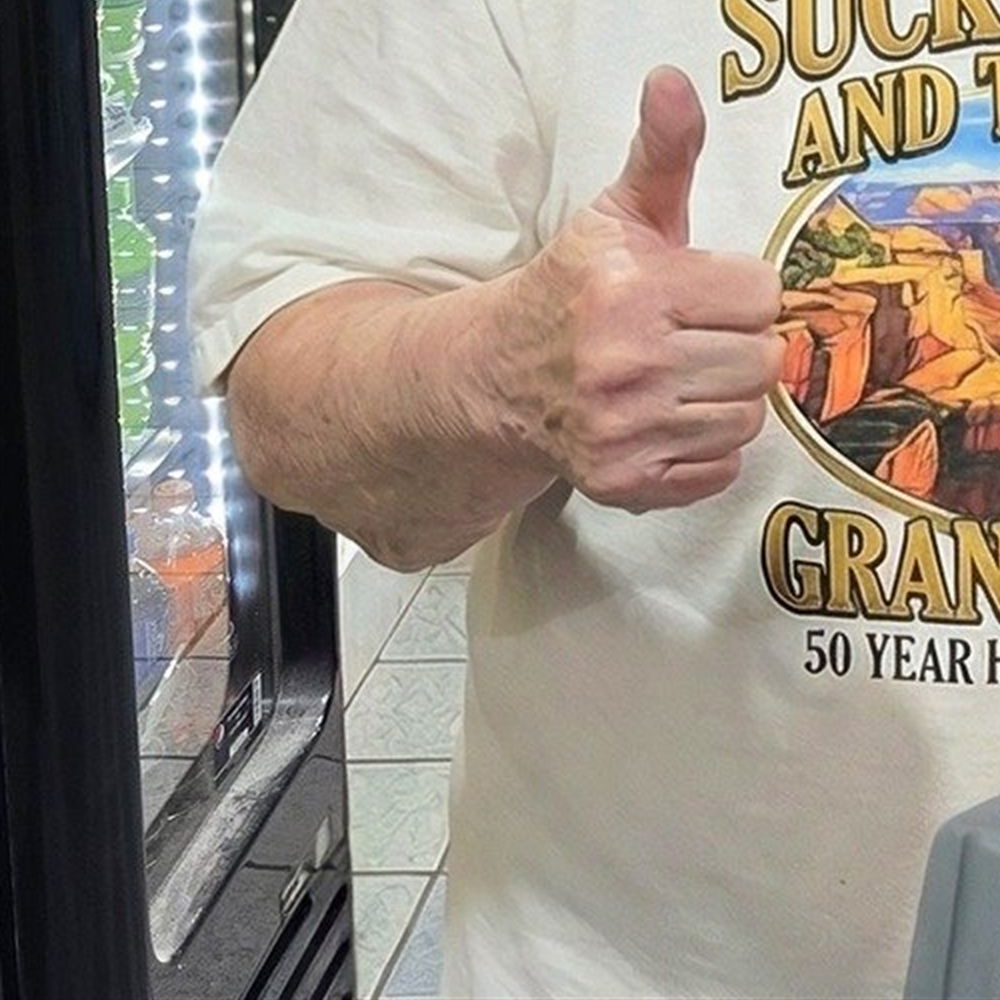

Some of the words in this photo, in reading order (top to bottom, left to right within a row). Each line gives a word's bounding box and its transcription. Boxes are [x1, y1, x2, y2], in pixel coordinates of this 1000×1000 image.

[782, 63, 961, 188] AND
[804, 629, 851, 677] 50
[865, 632, 974, 684] YEAR
